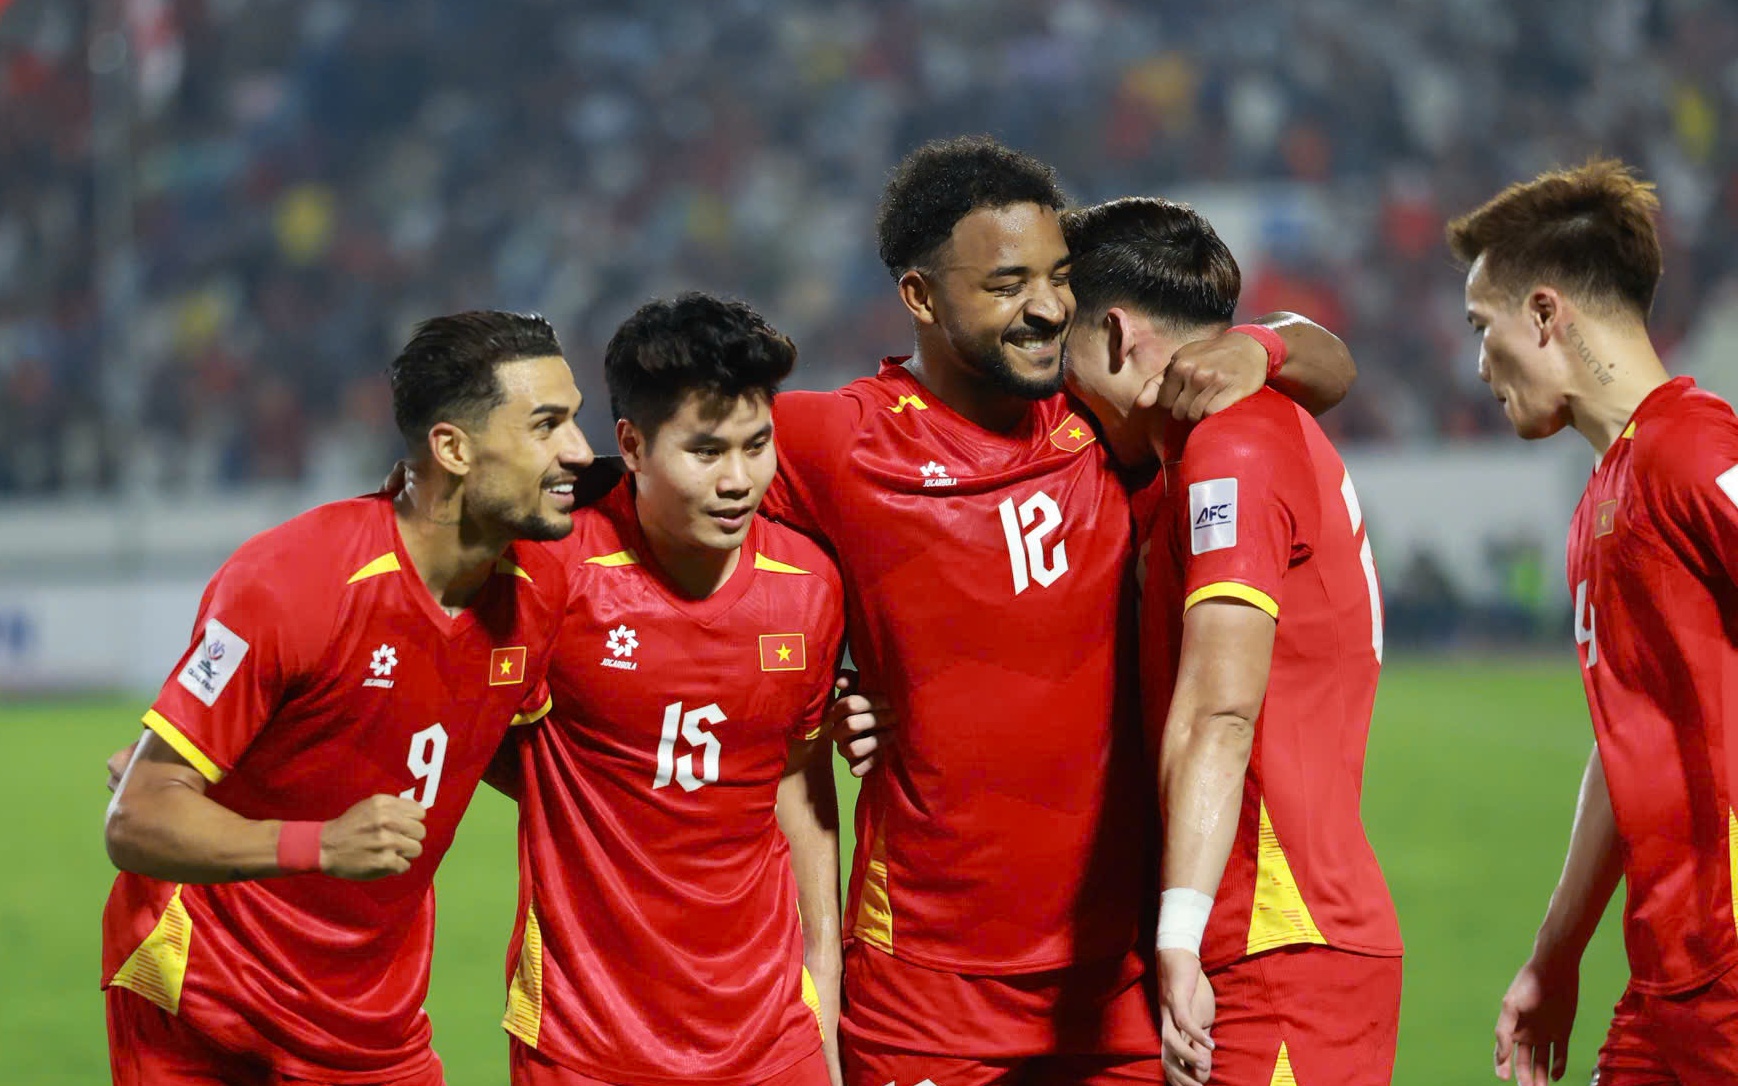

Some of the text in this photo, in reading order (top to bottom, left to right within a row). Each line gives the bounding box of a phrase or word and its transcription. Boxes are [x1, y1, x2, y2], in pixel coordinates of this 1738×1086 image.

[998, 490, 1070, 596] 12
[1195, 503, 1229, 525] AFC
[1574, 579, 1598, 669] 4
[400, 722, 449, 810] 9
[652, 700, 728, 793] 15
